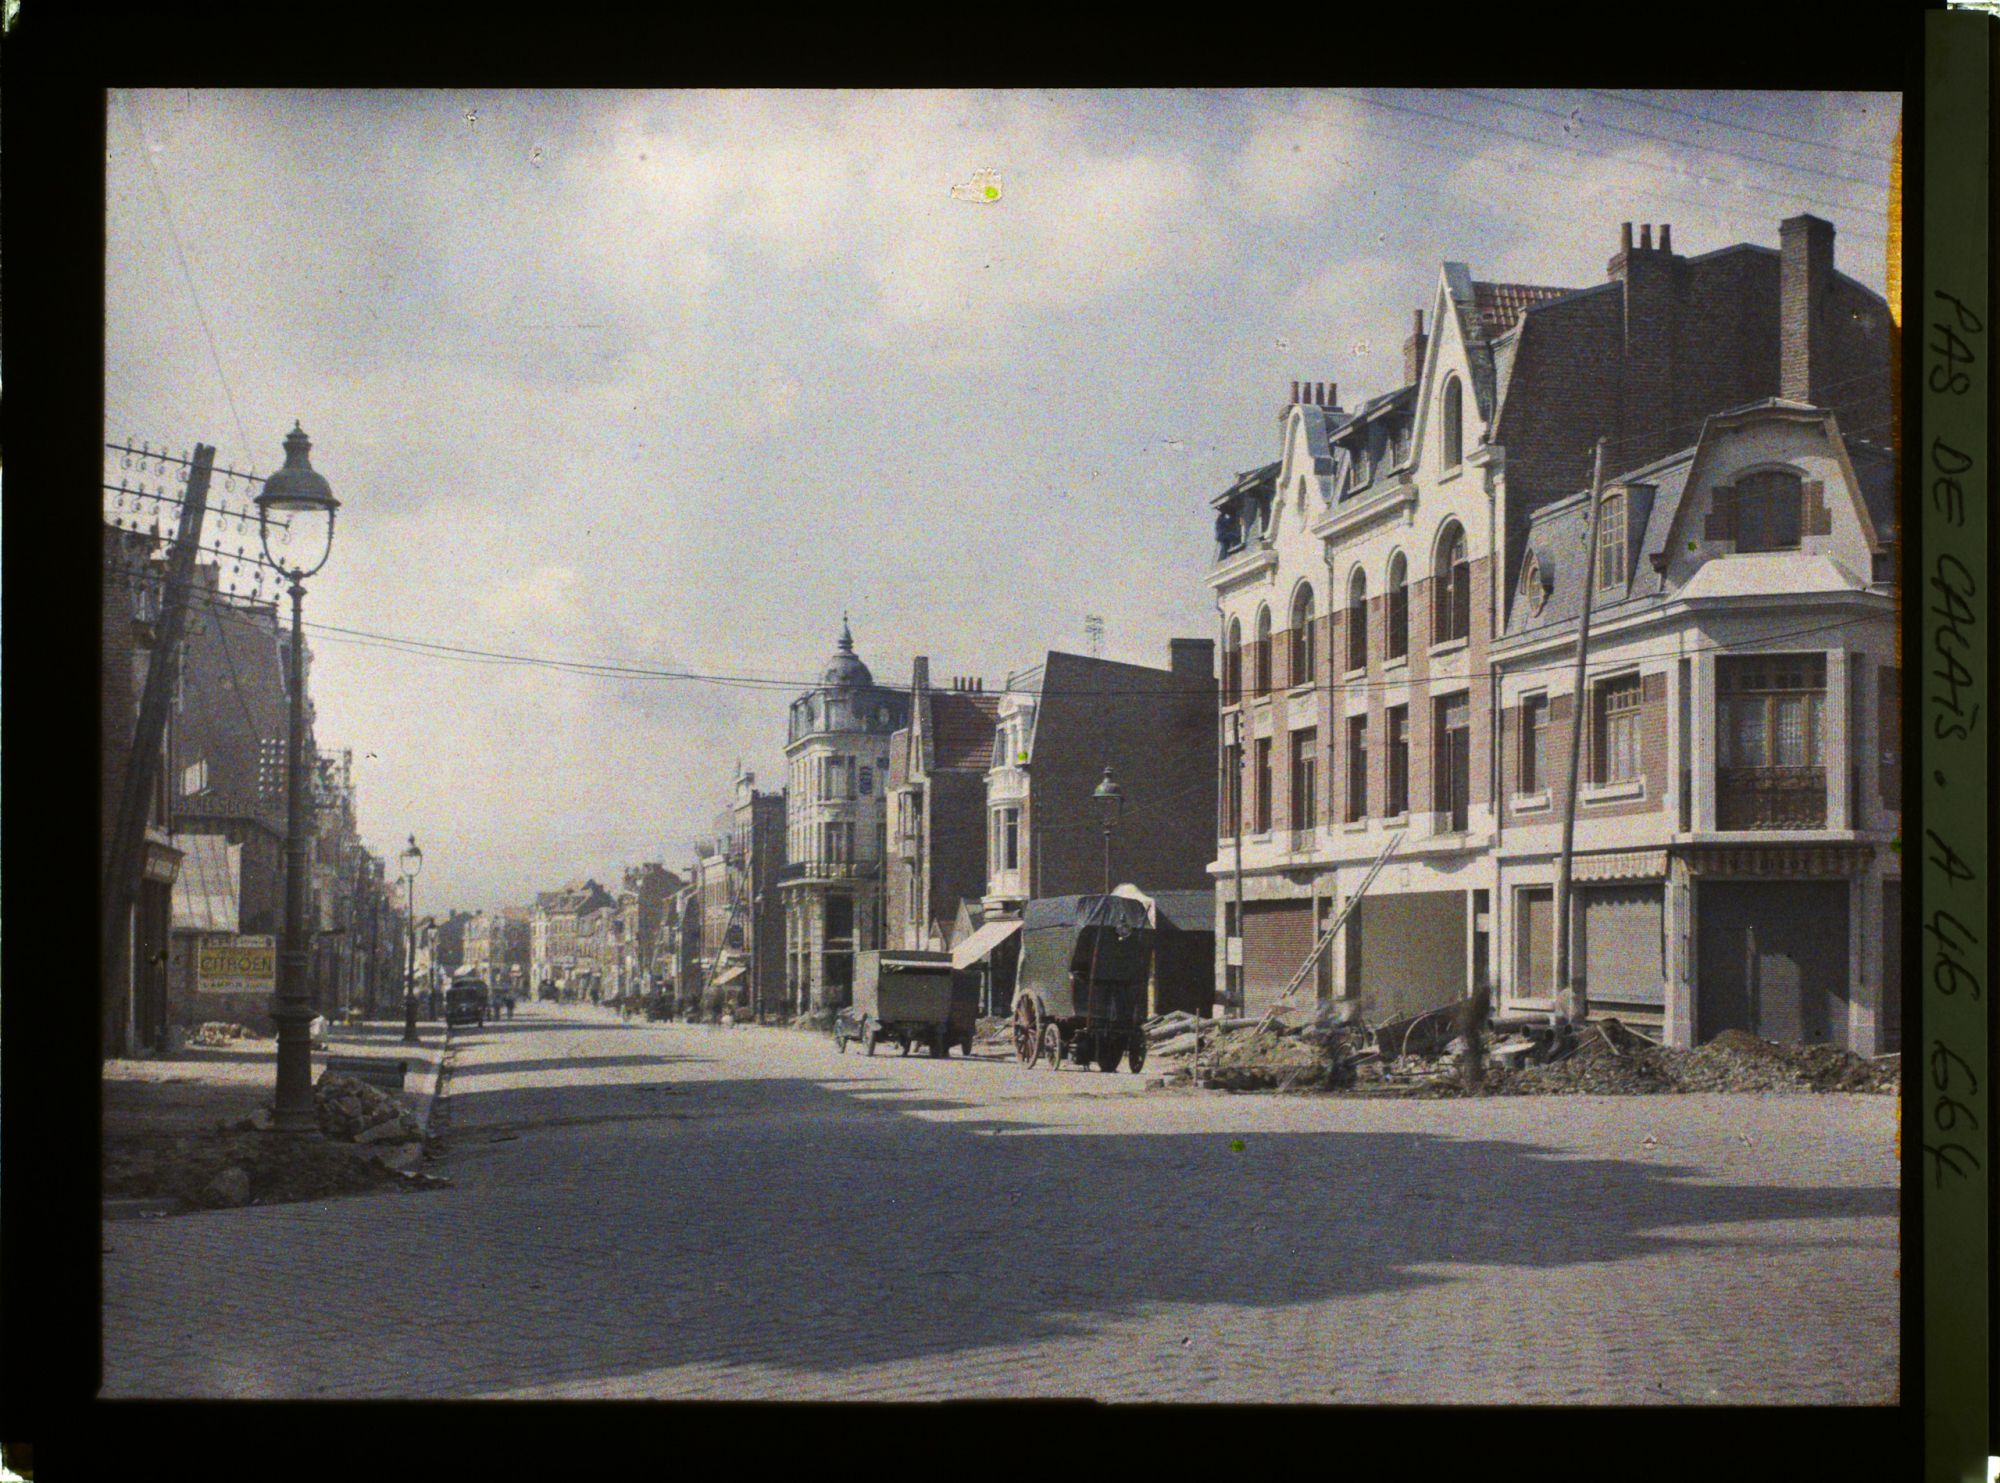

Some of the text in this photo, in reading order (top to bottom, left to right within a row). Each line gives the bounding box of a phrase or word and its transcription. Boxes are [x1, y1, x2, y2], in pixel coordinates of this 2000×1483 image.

[1928, 290, 1984, 396] PAS
[1931, 435, 1974, 527] DE
[1927, 829, 1976, 886] A
[1925, 910, 1981, 1000] 46
[1924, 1039, 1981, 1190] 664
